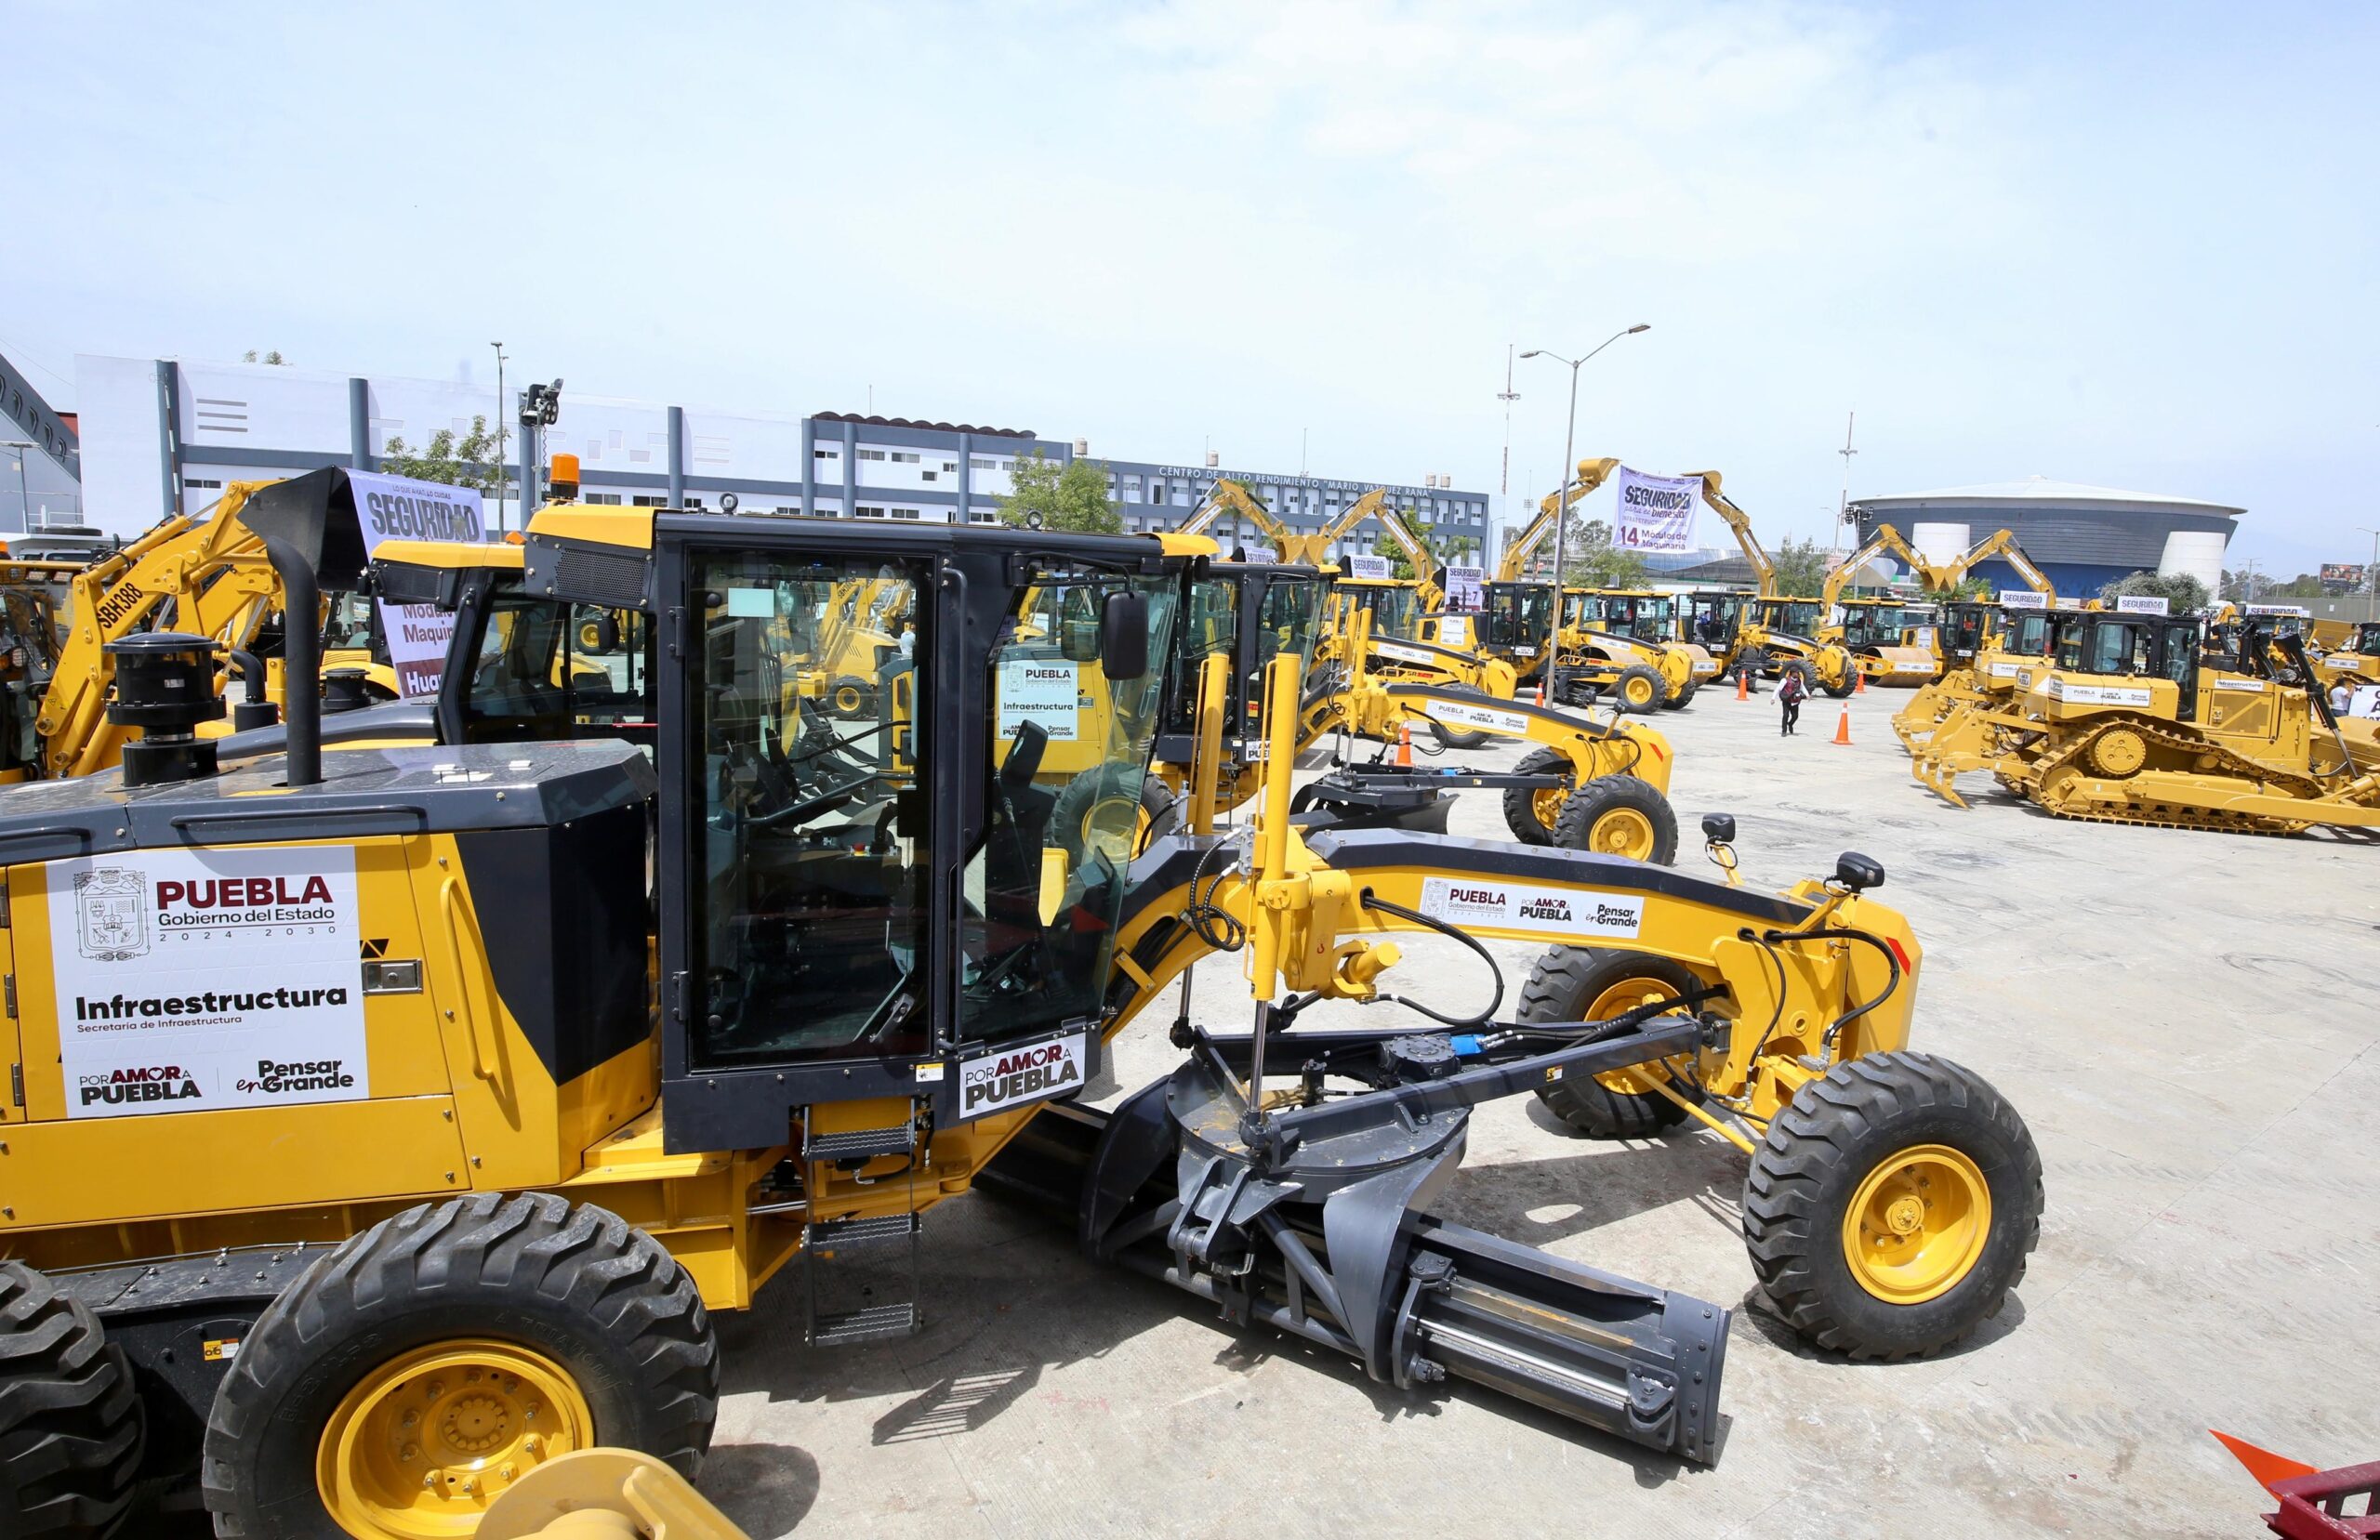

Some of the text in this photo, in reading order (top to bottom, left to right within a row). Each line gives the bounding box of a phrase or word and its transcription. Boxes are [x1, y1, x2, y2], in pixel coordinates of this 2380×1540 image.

[1158, 467, 1201, 478] CENTRO
[1224, 473, 1251, 481] ALTO
[1255, 474, 1319, 488] RENDIMIENTO
[1620, 526, 1639, 546] 14
[96, 582, 143, 629] SBH388
[1473, 591, 1478, 602] 7
[405, 671, 442, 694] Hua
[1025, 669, 1071, 678] PUEBLA
[1004, 702, 1073, 710] Infraestructura
[1438, 704, 1464, 715] PUEBLA
[1470, 715, 1494, 724] PUEBLA
[156, 875, 334, 911] PUEBLA
[1449, 888, 1506, 905] PUEBLA
[1448, 902, 1475, 910] Gobierno
[1486, 904, 1506, 913] Estado
[1519, 905, 1572, 921] PUEBLA
[1522, 899, 1535, 907] POR
[1534, 898, 1567, 909] AMOR
[1597, 903, 1635, 917] Pensar
[159, 907, 335, 926] Gobierno del Estado
[1597, 914, 1638, 928] Grande
[76, 988, 348, 1020] Infraestructura
[140, 1020, 155, 1030] de
[158, 1016, 243, 1028] Infraestructura
[258, 1059, 342, 1078] Pensar
[966, 1045, 1072, 1086] POR AMOR A
[80, 1066, 192, 1086] POR AMOR A
[262, 1072, 354, 1093] Grande
[966, 1060, 1079, 1110] PUEBLA
[80, 1080, 202, 1106] PUEBLA
